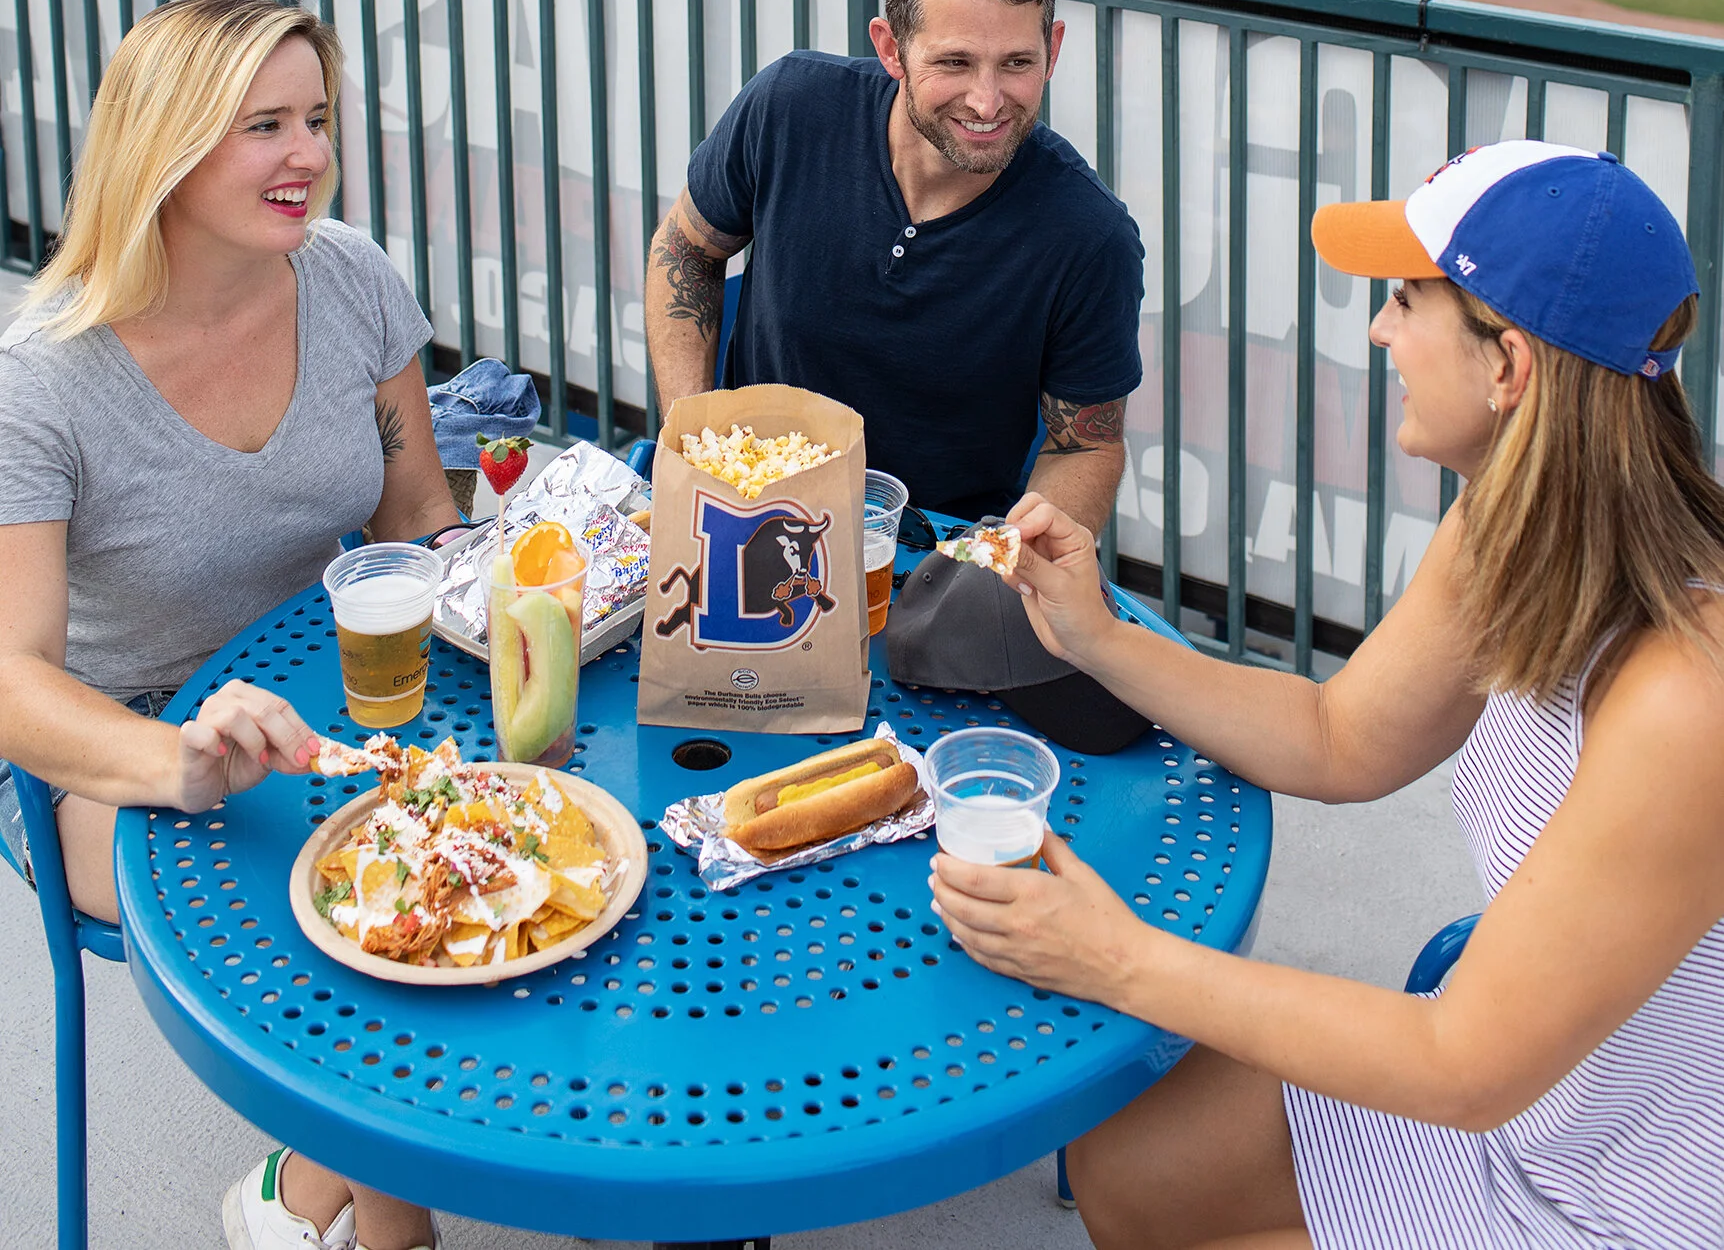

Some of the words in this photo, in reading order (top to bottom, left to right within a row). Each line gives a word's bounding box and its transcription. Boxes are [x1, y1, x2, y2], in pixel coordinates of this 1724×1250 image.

[718, 690, 743, 698] Durham
[684, 694, 737, 705] environmentally
[738, 698, 764, 706] friendly
[708, 701, 729, 709] which
[757, 702, 805, 711] biodegradable
